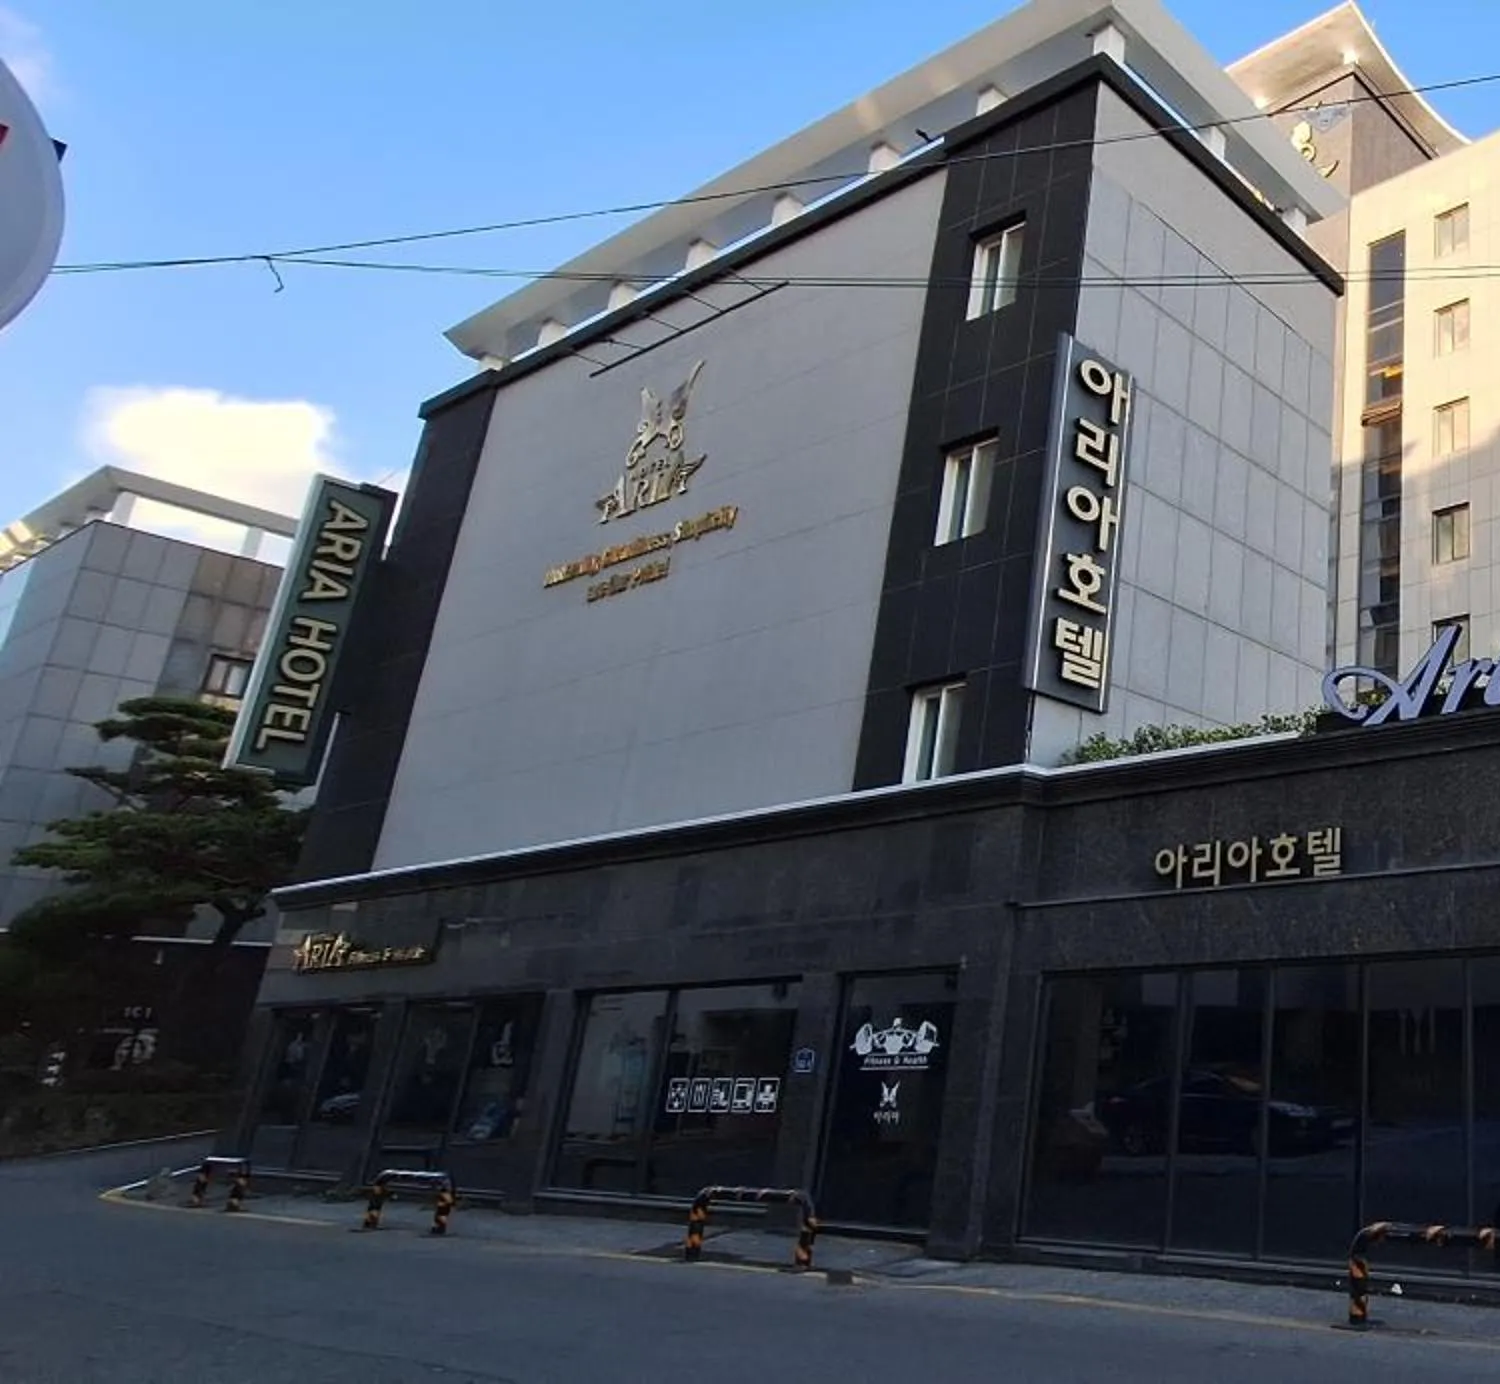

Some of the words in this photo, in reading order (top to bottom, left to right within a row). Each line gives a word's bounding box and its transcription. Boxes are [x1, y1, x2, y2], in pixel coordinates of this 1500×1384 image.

[596, 452, 707, 525] ARIA
[1055, 358, 1129, 690] 아리아호텔
[302, 500, 369, 600] ARIA
[256, 616, 338, 750] HOTEL
[1154, 827, 1342, 890] 아리아호텔
